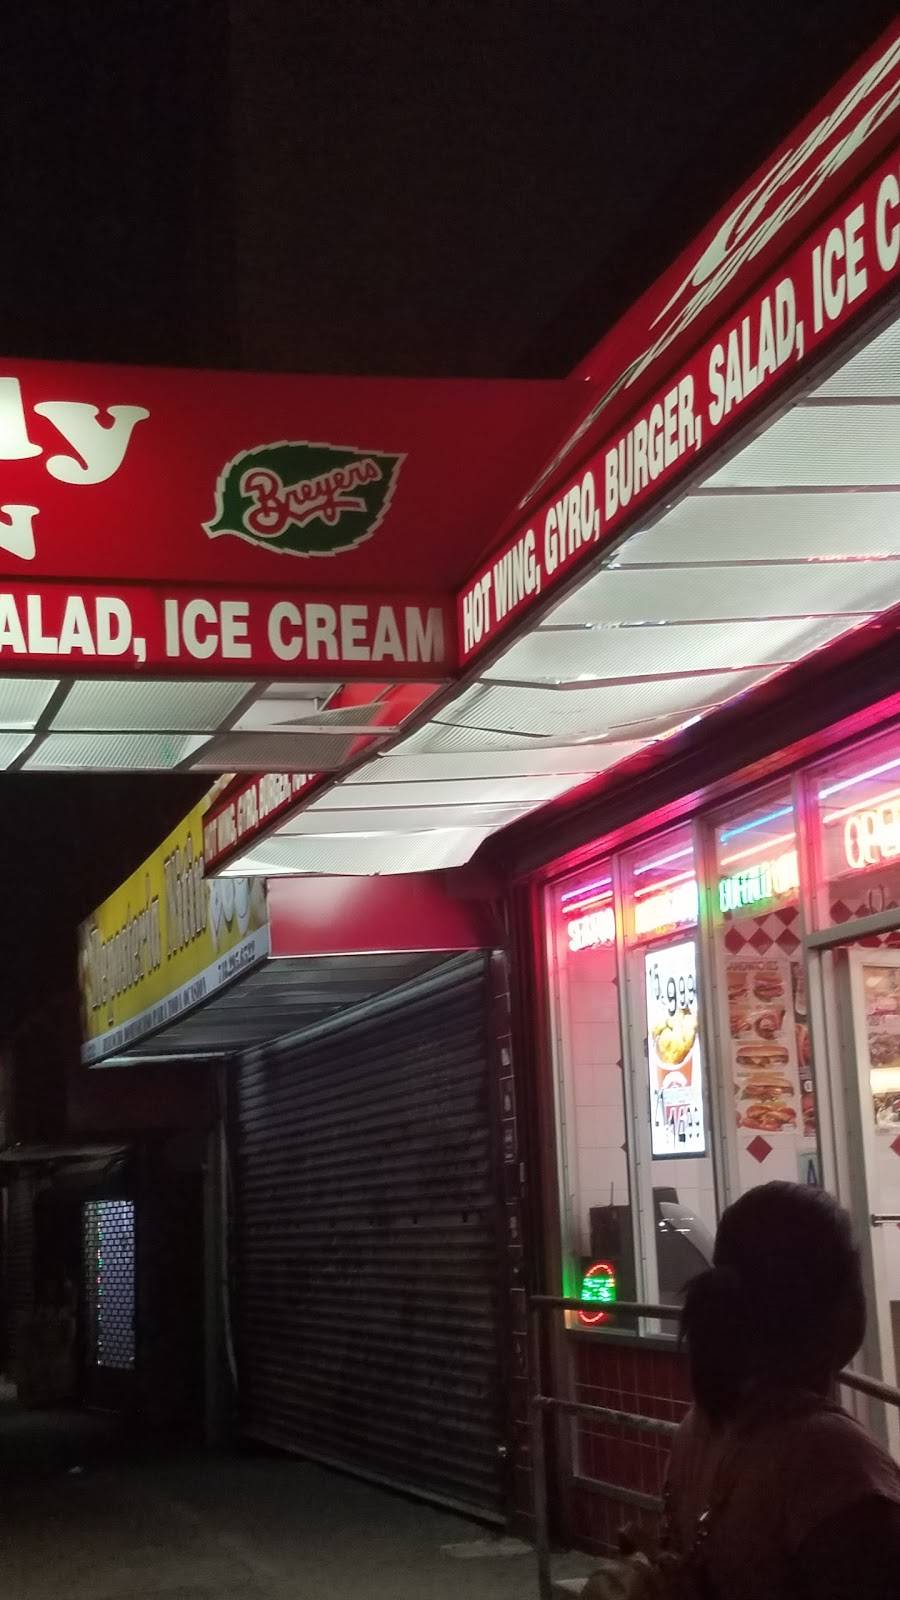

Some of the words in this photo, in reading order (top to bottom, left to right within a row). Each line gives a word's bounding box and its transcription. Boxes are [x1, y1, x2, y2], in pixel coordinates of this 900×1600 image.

[462, 571, 492, 654] HOT
[493, 528, 541, 622] WING,
[543, 471, 600, 575] GYRO,
[604, 374, 703, 522] BURGER,
[707, 277, 805, 426] SALAD,
[811, 202, 868, 334] ICE
[242, 459, 381, 538] Breyers
[164, 599, 251, 660] ICE
[267, 601, 446, 663] CREAM
